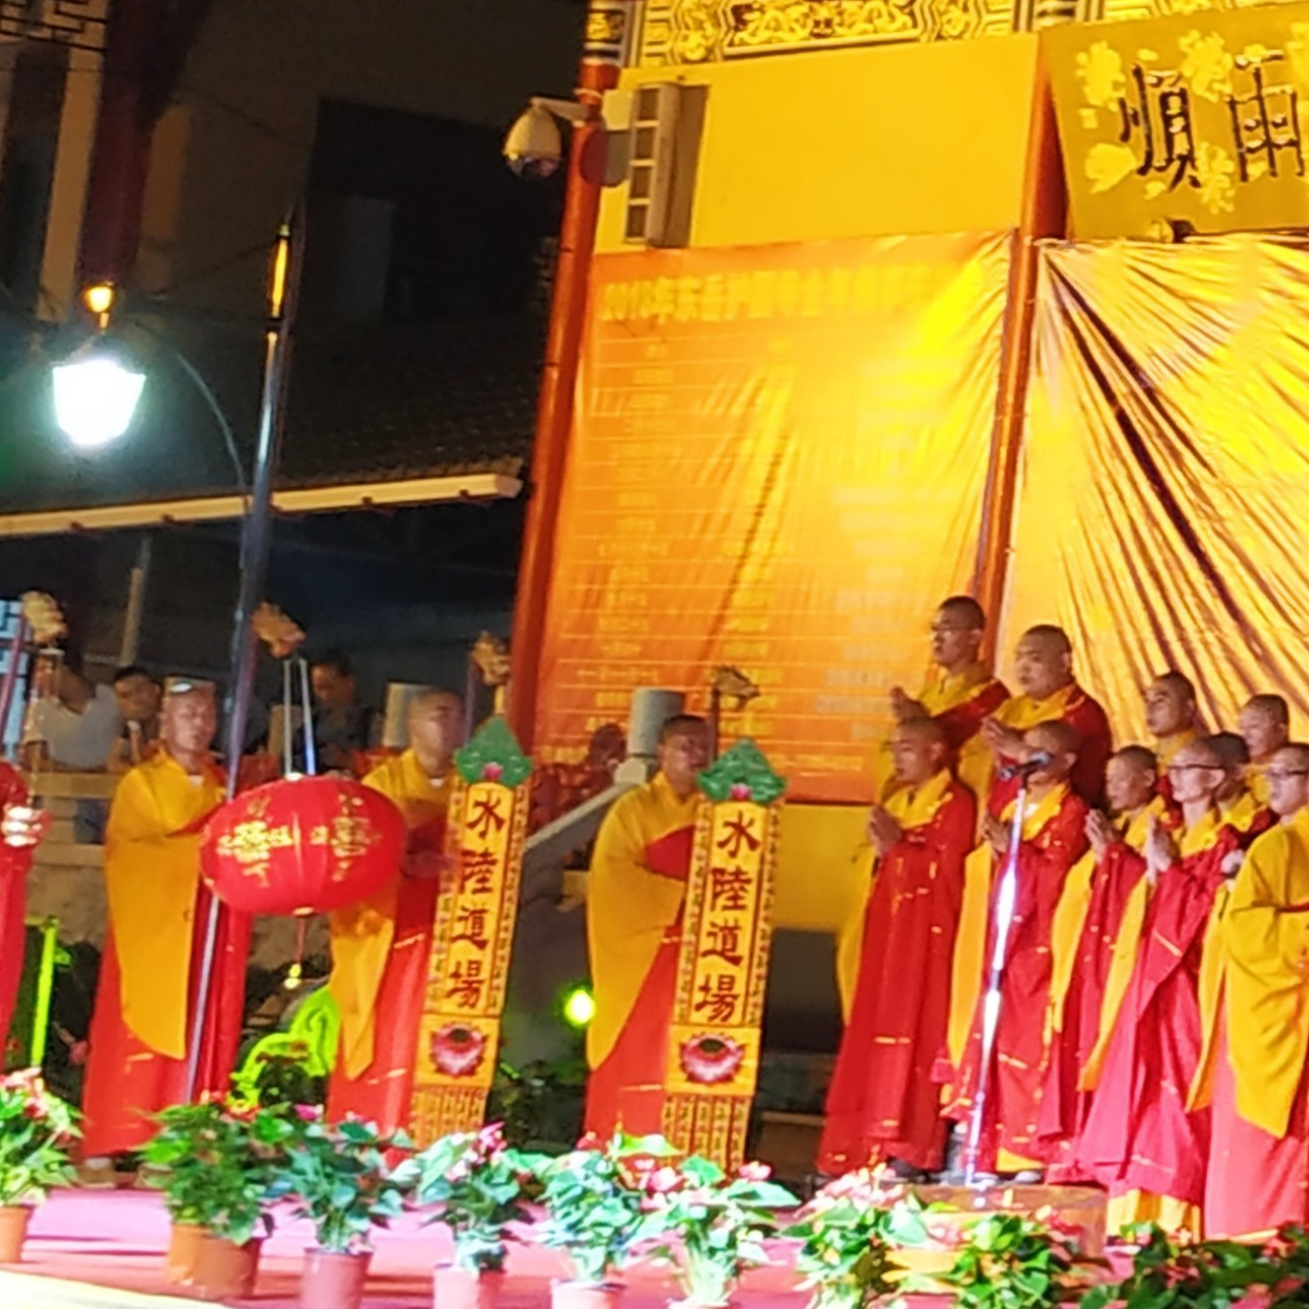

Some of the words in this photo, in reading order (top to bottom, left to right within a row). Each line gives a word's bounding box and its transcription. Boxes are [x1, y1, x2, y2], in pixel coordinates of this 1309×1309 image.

[443, 795, 506, 1009] 水陸道場
[694, 810, 760, 1023] 水陸道場
